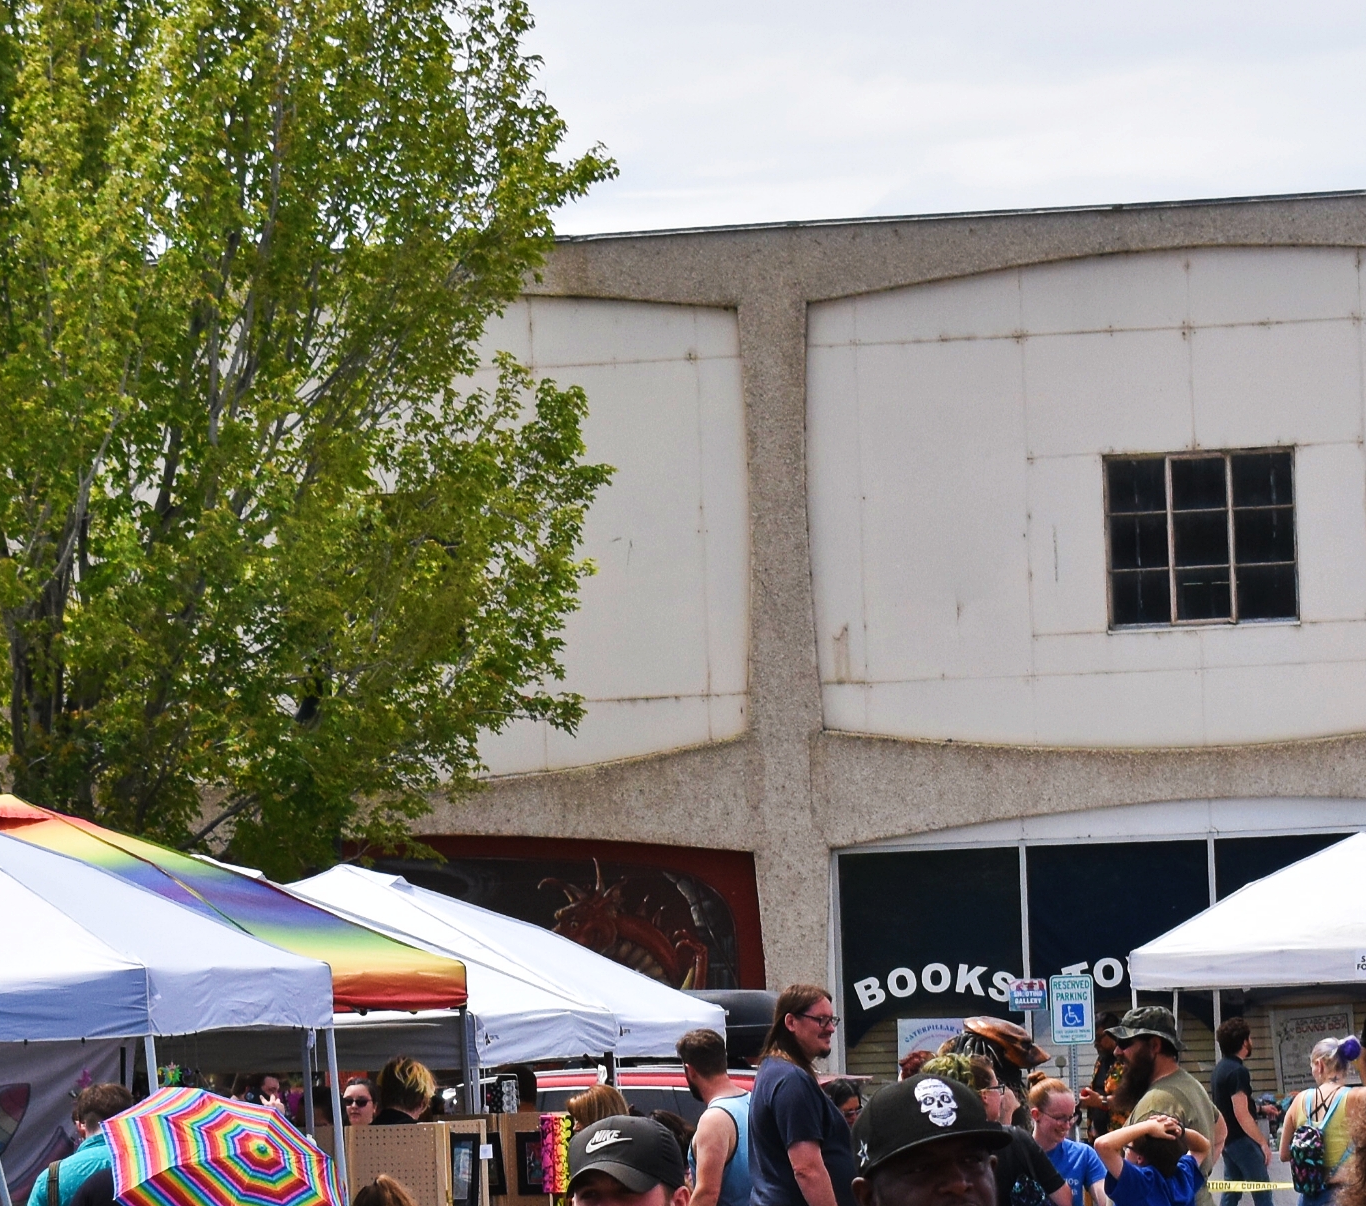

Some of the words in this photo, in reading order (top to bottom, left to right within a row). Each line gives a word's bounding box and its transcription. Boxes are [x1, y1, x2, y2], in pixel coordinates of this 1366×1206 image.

[853, 963, 1017, 1010] BOOKS
[1053, 980, 1090, 990] RESERVED
[1055, 992, 1087, 1001] PARKING
[1328, 1022, 1347, 1030] BOX
[905, 1024, 955, 1042] CATERPILLAR
[591, 1130, 621, 1144] NIKE
